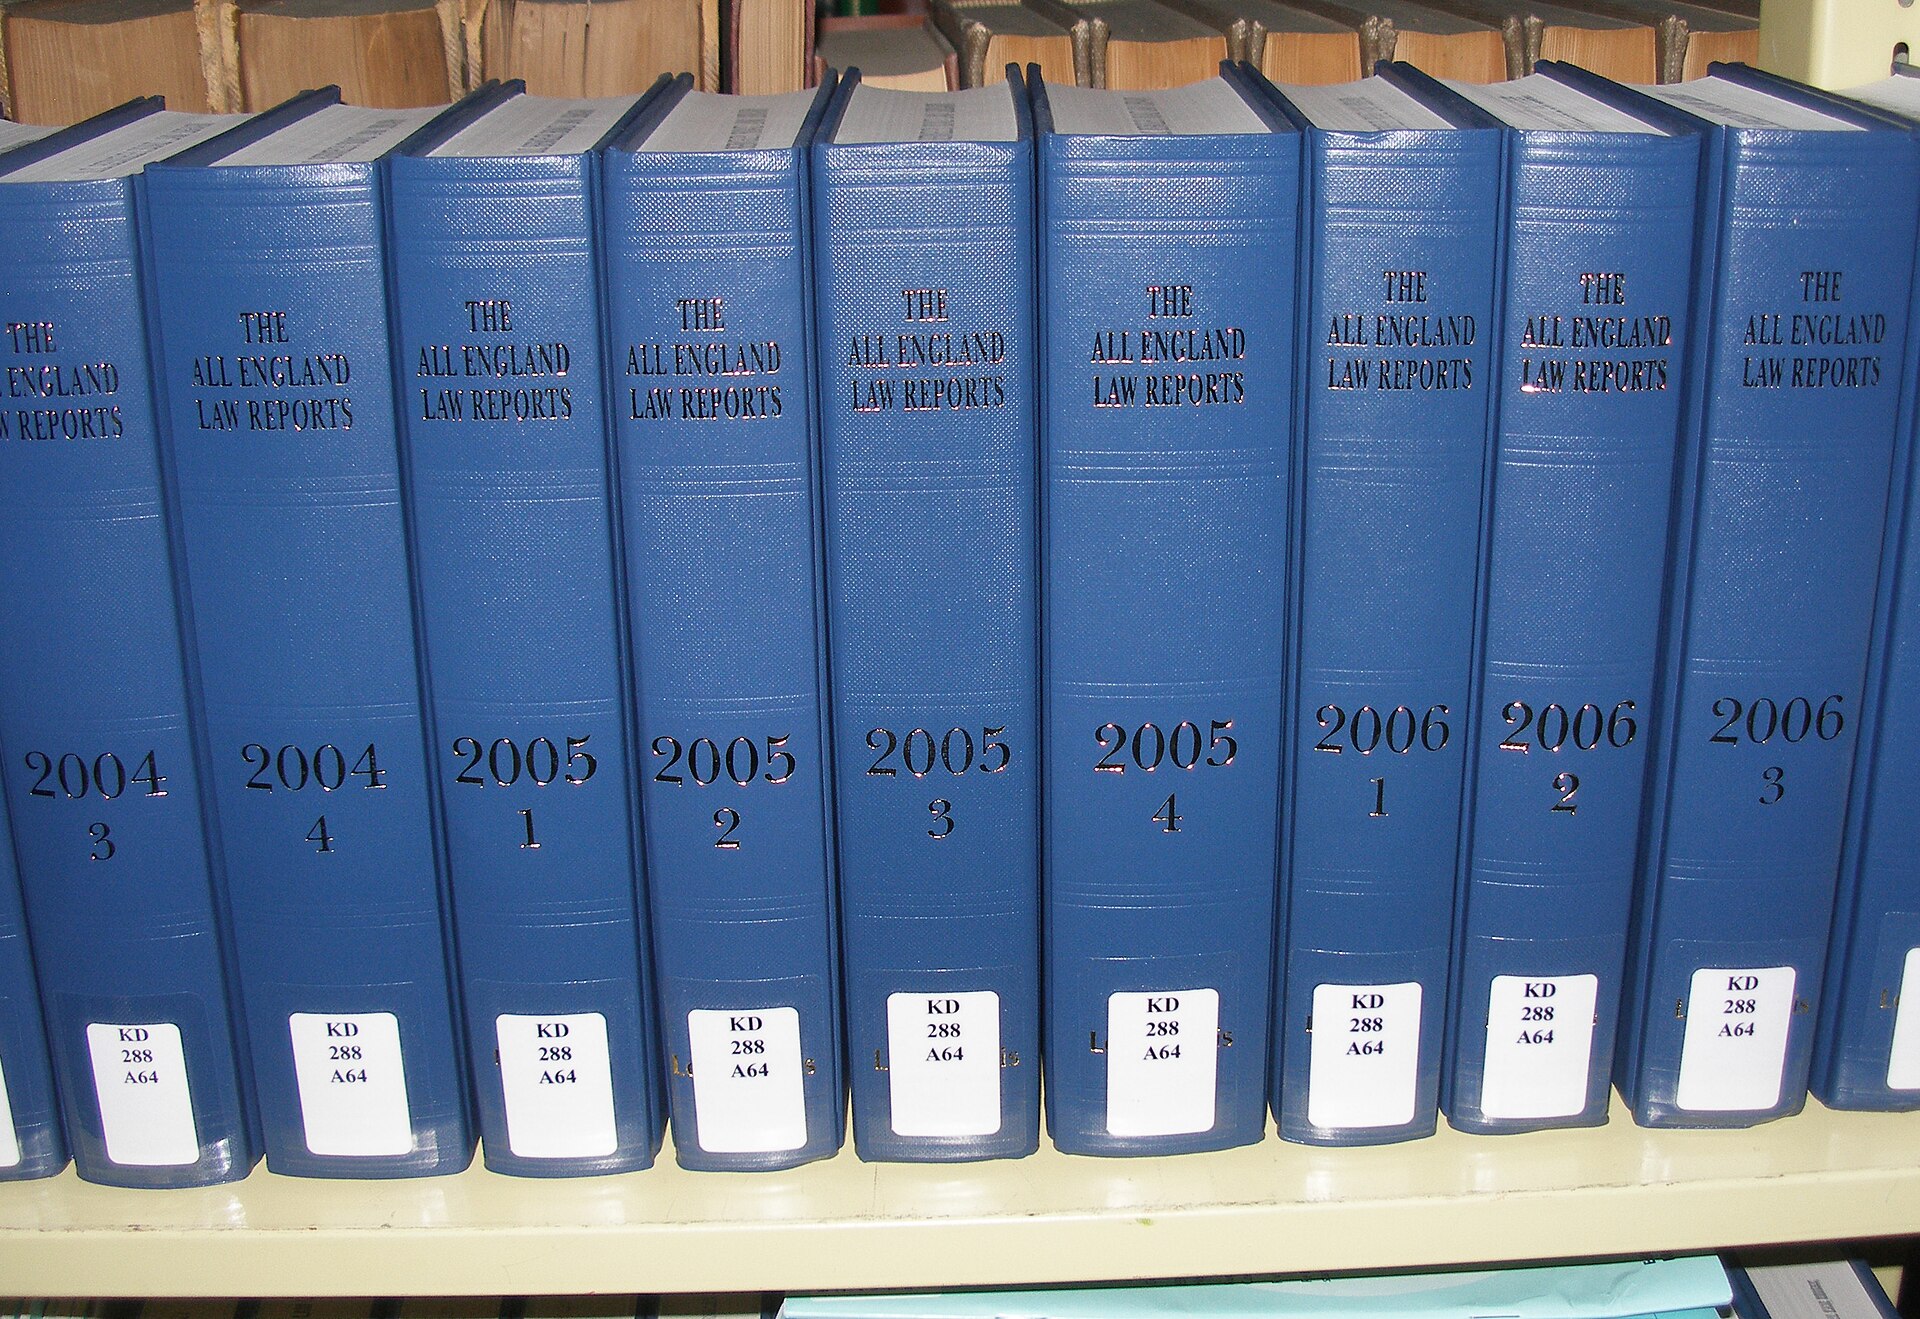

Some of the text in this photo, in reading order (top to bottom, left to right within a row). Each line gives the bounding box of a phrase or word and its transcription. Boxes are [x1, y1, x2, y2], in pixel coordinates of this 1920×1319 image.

[1146, 286, 1194, 318] THE
[1383, 271, 1428, 303] THE
[1579, 271, 1626, 305] THE
[1801, 271, 1843, 302] THE
[464, 300, 514, 332] THE
[676, 298, 726, 332] THE
[903, 289, 949, 322] THE
[6, 322, 57, 354] THE
[240, 311, 290, 345] THE
[1327, 315, 1476, 347] ALL ENGLAND
[1520, 315, 1671, 348] ALL ENGLAND
[1743, 313, 1887, 346] ALL ENGLAND
[416, 343, 571, 377] ALL ENGLAND
[626, 341, 782, 376] ALL ENGLAND
[847, 332, 1005, 368] ALL ENGLAND
[1090, 327, 1246, 364] ALL ENGLAND
[8, 362, 120, 398] ENGLAND
[191, 353, 351, 388] ALL ENGLAND
[1327, 358, 1474, 391] LAW REPORTS
[1520, 358, 1668, 393] LAW REPORTS
[1742, 356, 1880, 389] LAW REPORTS
[419, 387, 572, 421] LAW REPORTS
[629, 386, 783, 420] LAW REPORTS
[851, 377, 1006, 413] LAW REPORTS
[1093, 372, 1245, 408] LAW REPORTS
[18, 407, 124, 441] REPORTS
[196, 398, 354, 431] LAW REPORTS
[1313, 703, 1451, 756] 2006
[1499, 699, 1638, 756] 2006
[1708, 693, 1846, 748] 2006
[451, 733, 598, 789] 2005
[652, 733, 797, 788] 2005
[865, 725, 1012, 778] 2005
[1093, 719, 1238, 776] 2005
[24, 749, 169, 800] 2004
[241, 742, 388, 794] 2004
[1368, 776, 1390, 818] 1
[1550, 772, 1580, 817] 2
[1757, 765, 1785, 806] 3
[516, 808, 543, 850] 1
[712, 806, 742, 850] 2
[926, 798, 955, 840] 3
[1150, 792, 1184, 834] 4
[88, 821, 117, 862] 3
[304, 814, 335, 853] 4
[1524, 982, 1557, 998] KD
[1727, 975, 1759, 991] KD
[927, 999, 960, 1015] KD
[1147, 997, 1180, 1013] KD
[1351, 994, 1385, 1009] KD
[1521, 1006, 1555, 1022] 288
[1723, 998, 1756, 1014] 288
[118, 1027, 150, 1043] KD
[326, 1022, 359, 1037] KD
[537, 1023, 569, 1038] KD
[730, 1016, 763, 1032] KD
[927, 1022, 961, 1038] 288
[1146, 1020, 1179, 1037] 288
[1349, 1017, 1383, 1033] 288
[1516, 1029, 1554, 1045] A64
[1718, 1022, 1755, 1037] A64
[121, 1049, 153, 1063] 288
[328, 1045, 362, 1061] 288
[538, 1046, 572, 1062] 288
[730, 1039, 765, 1055] 288
[926, 1046, 964, 1062] A64
[1143, 1044, 1181, 1061] A64
[1346, 1040, 1384, 1056] A64
[124, 1070, 159, 1084] A64
[331, 1068, 368, 1083] A64
[539, 1069, 577, 1084] A64
[731, 1062, 769, 1078] A64
